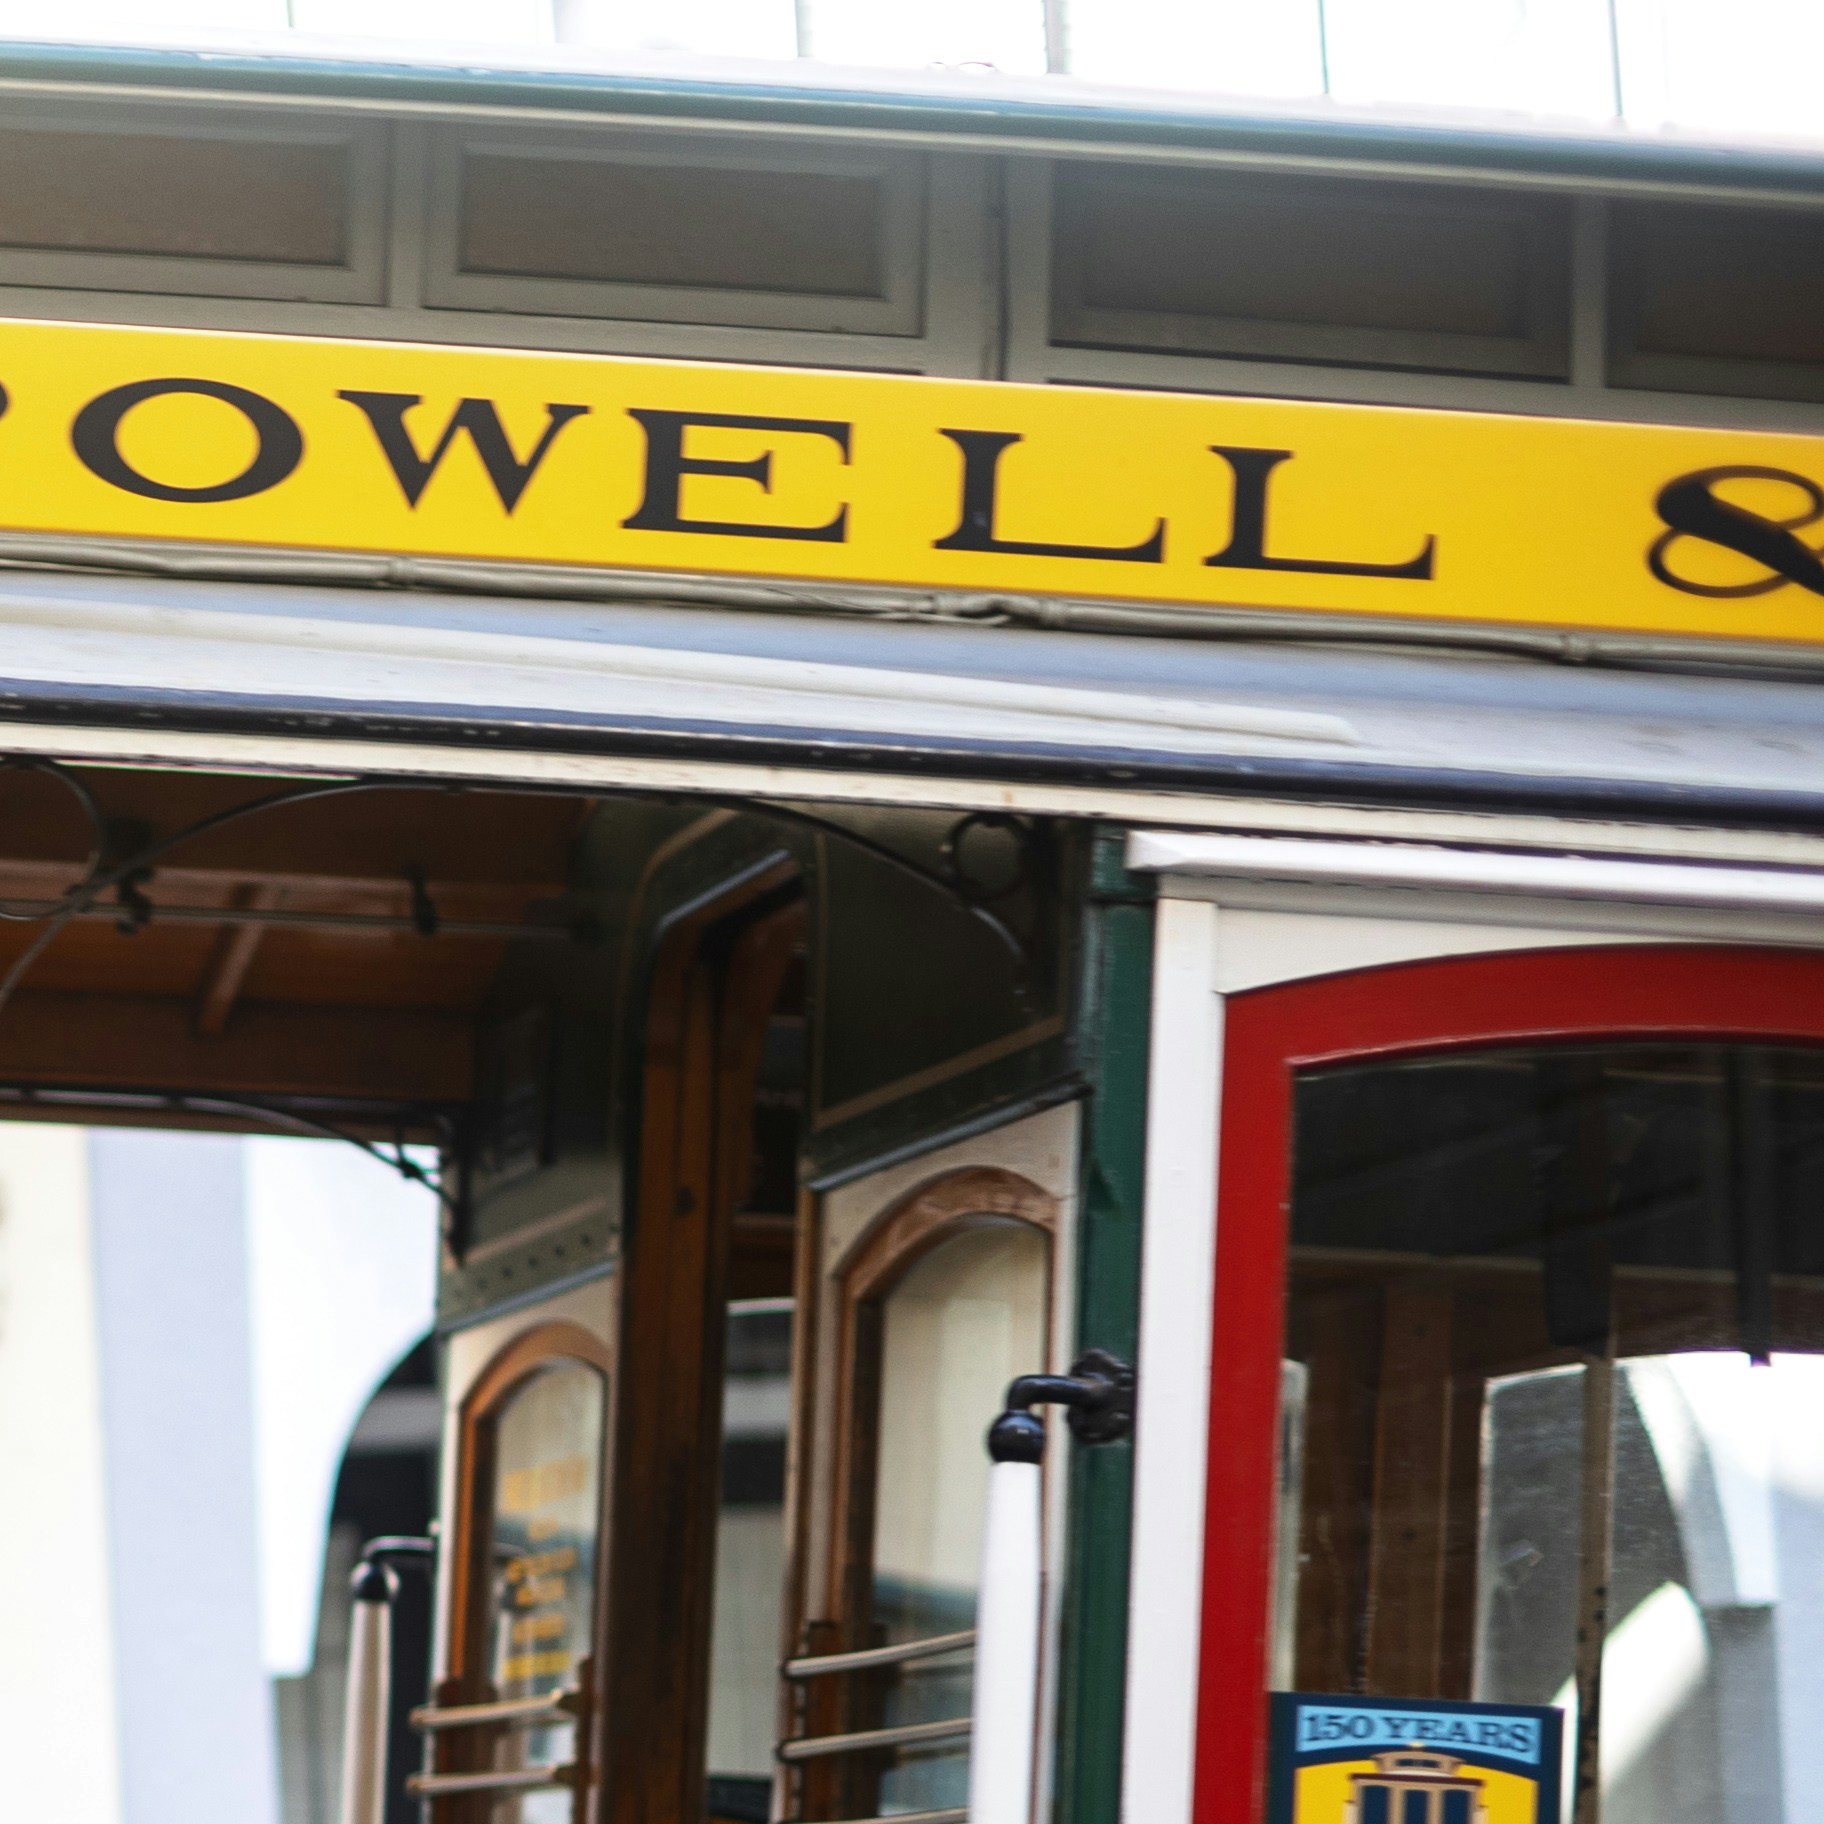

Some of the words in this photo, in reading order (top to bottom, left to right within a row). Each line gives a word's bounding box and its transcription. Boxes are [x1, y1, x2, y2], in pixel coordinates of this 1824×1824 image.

[1648, 465, 1824, 598] &
[1305, 1714, 1375, 1742] 150
[1381, 1716, 1532, 1753] YEARS
